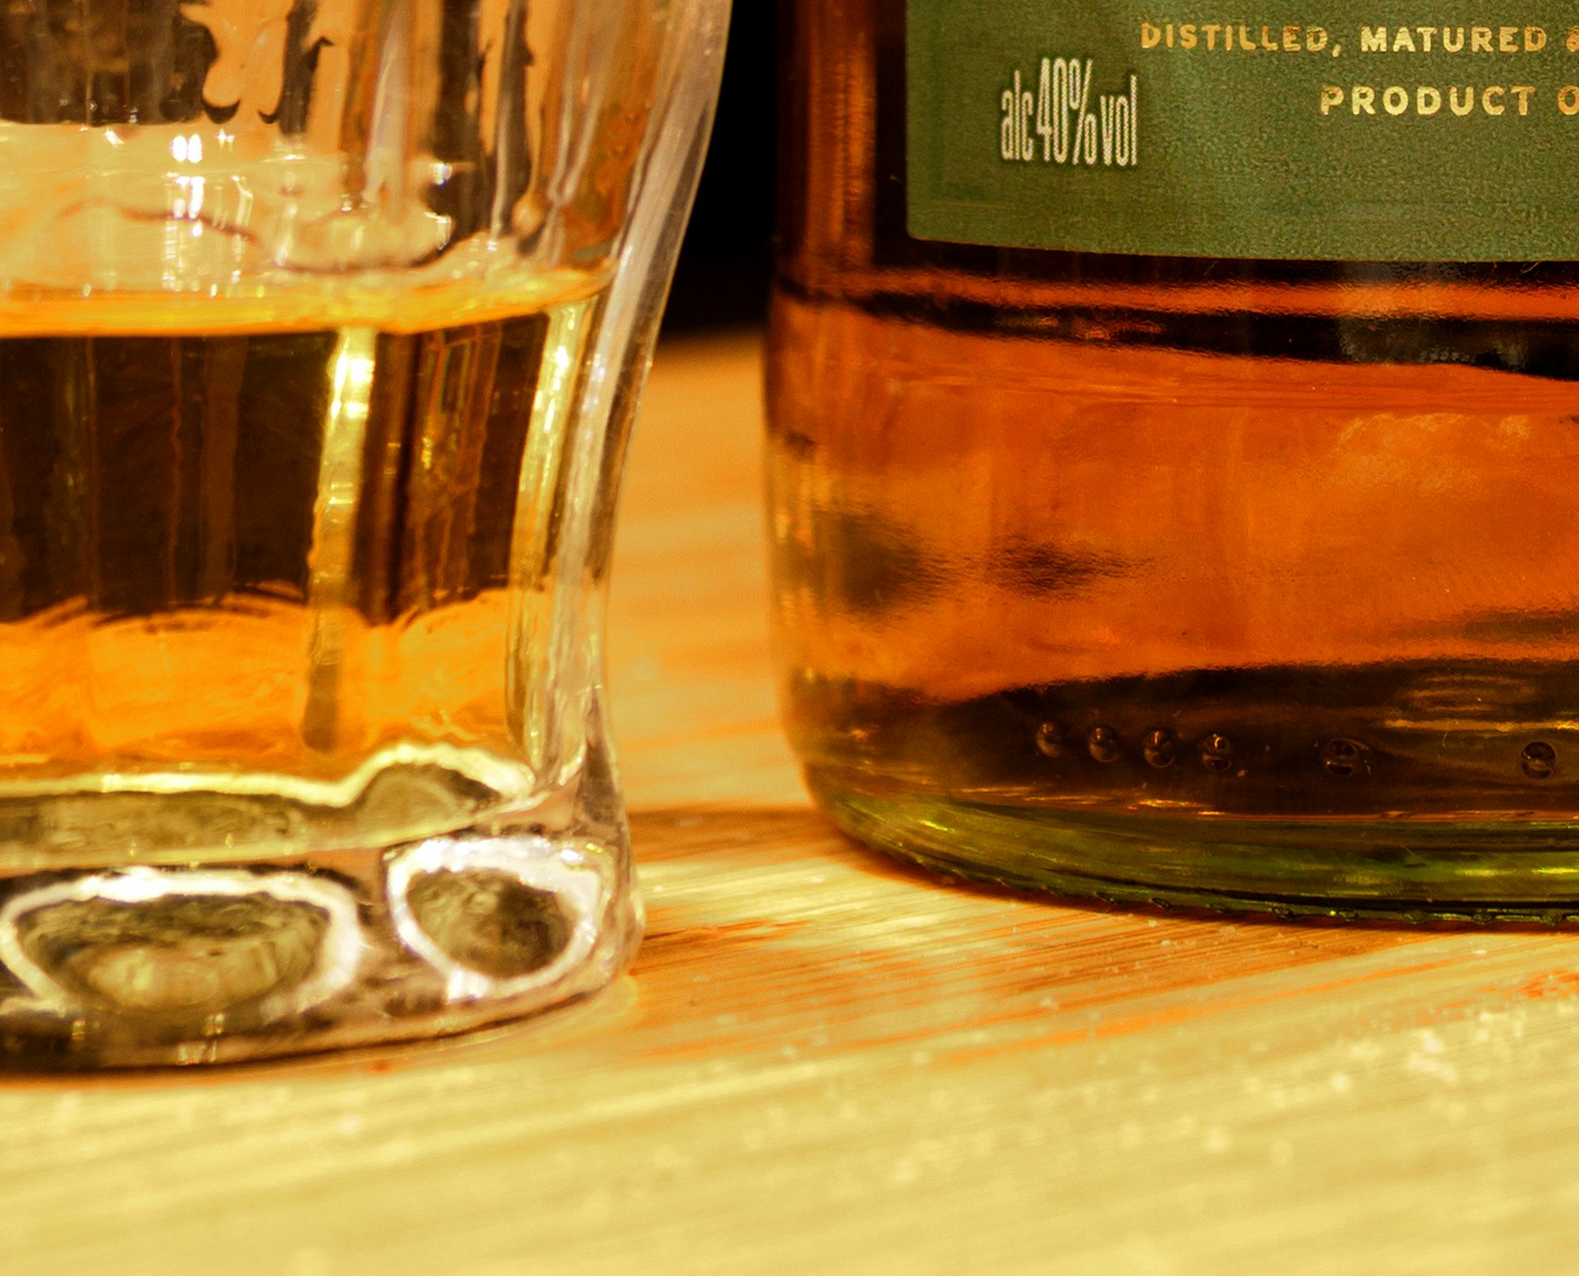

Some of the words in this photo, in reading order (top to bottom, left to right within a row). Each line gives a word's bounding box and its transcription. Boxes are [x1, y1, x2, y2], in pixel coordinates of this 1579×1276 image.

[1140, 21, 1341, 58] DISTILLED,
[1359, 25, 1548, 54] MATURED
[1320, 84, 1536, 117] PRODUCT
